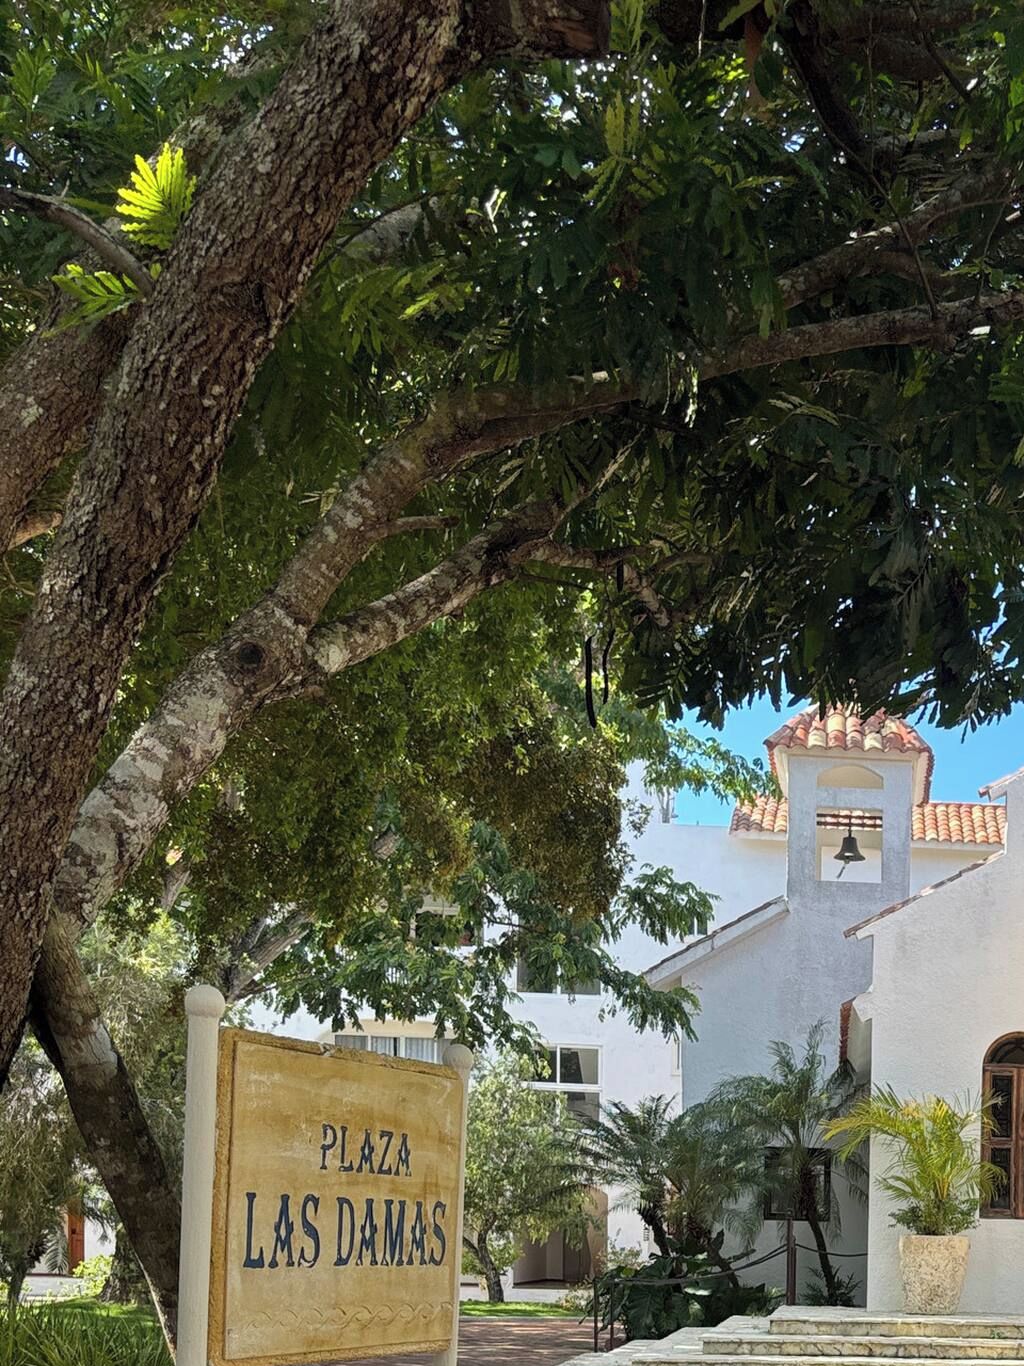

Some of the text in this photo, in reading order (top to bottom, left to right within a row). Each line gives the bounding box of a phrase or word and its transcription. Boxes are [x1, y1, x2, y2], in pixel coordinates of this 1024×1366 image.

[319, 1123, 412, 1177] PLAZA
[243, 1192, 447, 1268] LAS DAMAS
